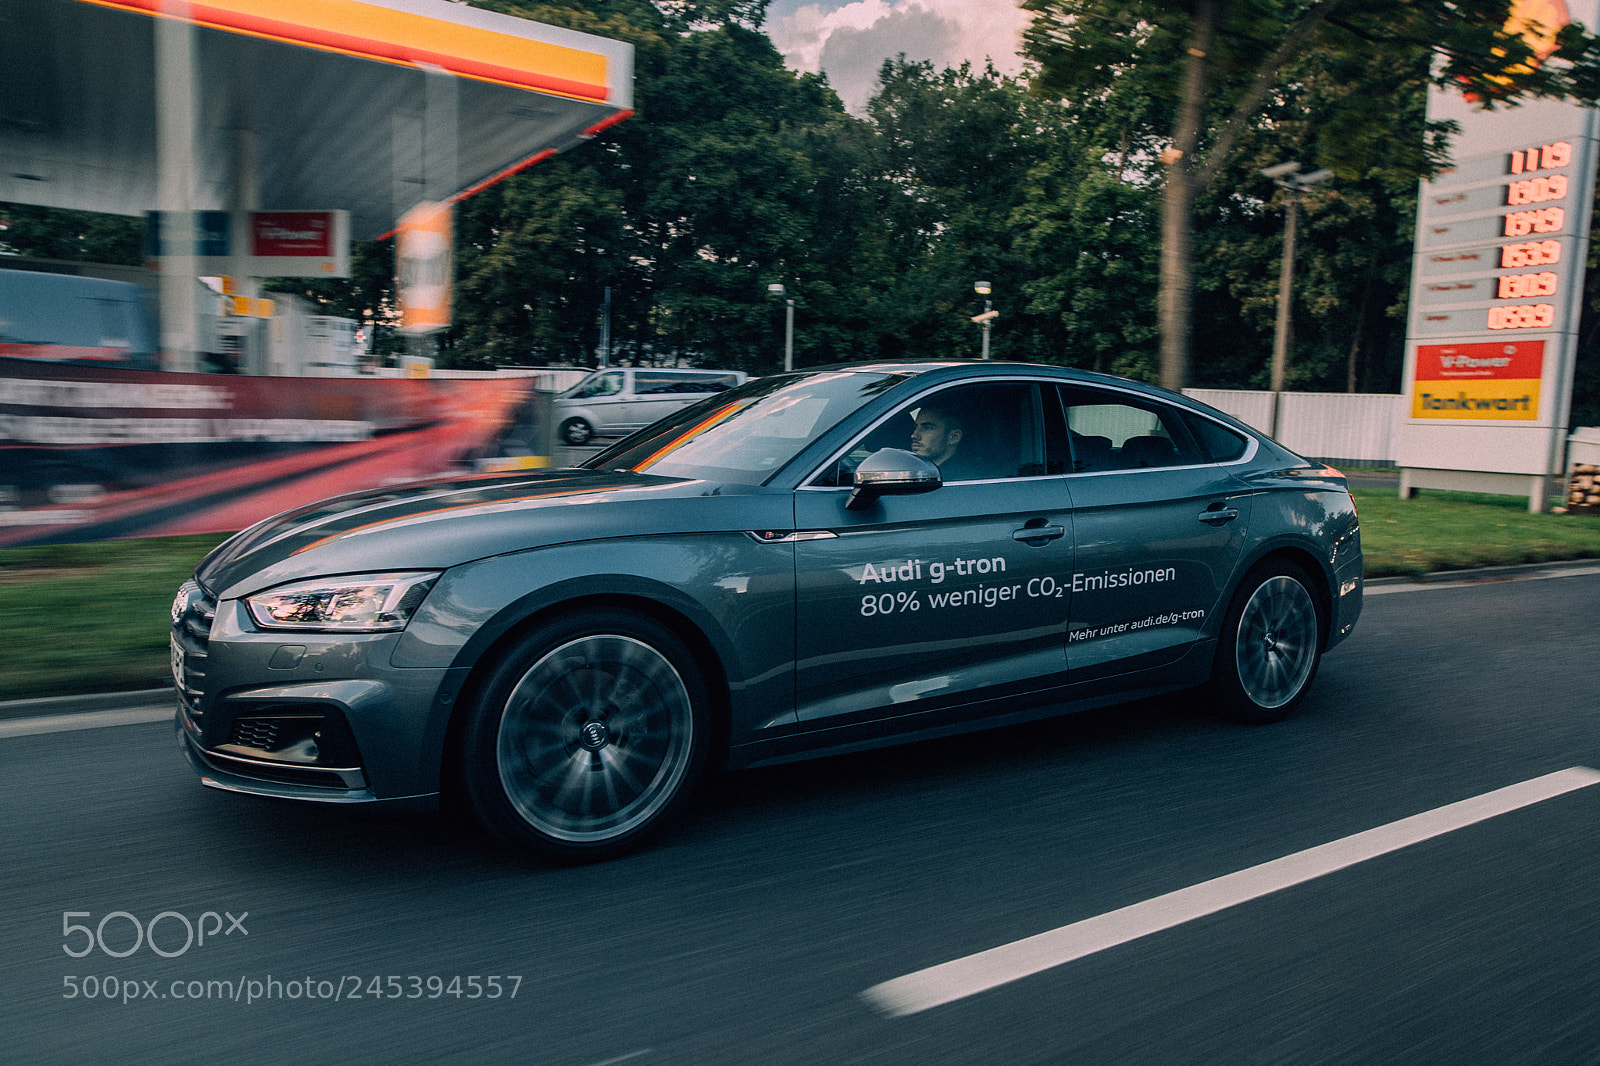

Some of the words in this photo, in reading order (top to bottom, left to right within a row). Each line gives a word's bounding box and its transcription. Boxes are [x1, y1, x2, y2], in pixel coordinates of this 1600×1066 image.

[1440, 355, 1512, 368] V-Power
[1421, 392, 1530, 411] Tankwart
[860, 559, 922, 585] Audi
[929, 556, 1006, 584] g-tron
[860, 591, 921, 617] 80%
[928, 584, 1021, 608] weniger
[1068, 628, 1098, 642] Mehr
[1100, 622, 1129, 636] unter
[1130, 609, 1205, 630] audi.de/g-tron
